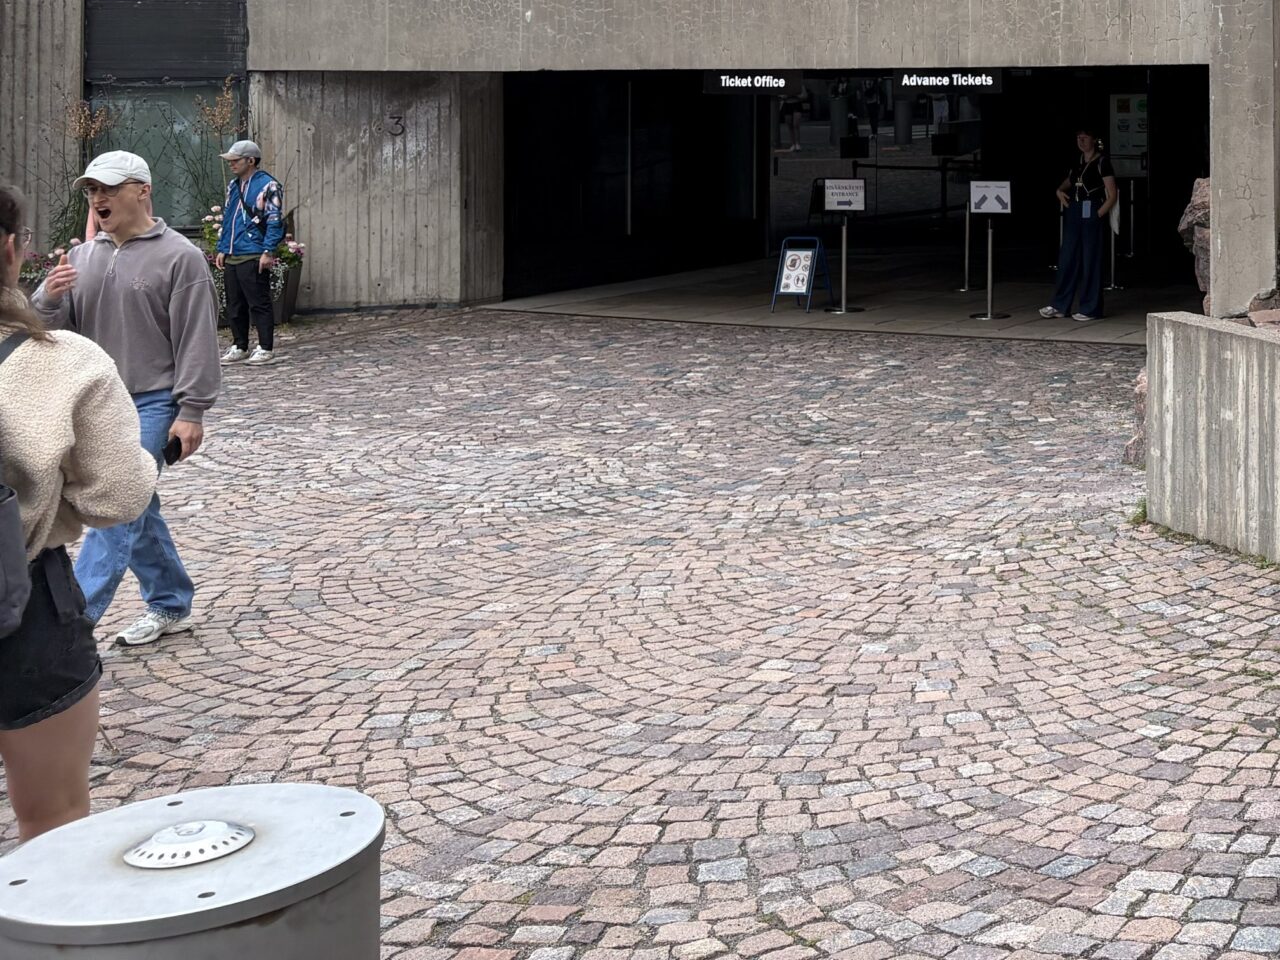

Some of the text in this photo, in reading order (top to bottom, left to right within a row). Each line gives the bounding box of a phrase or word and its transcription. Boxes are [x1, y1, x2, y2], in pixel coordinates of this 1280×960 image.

[720, 76, 786, 88] Ticket Office
[901, 74, 994, 86] Advance Tickets
[389, 116, 405, 136] 3
